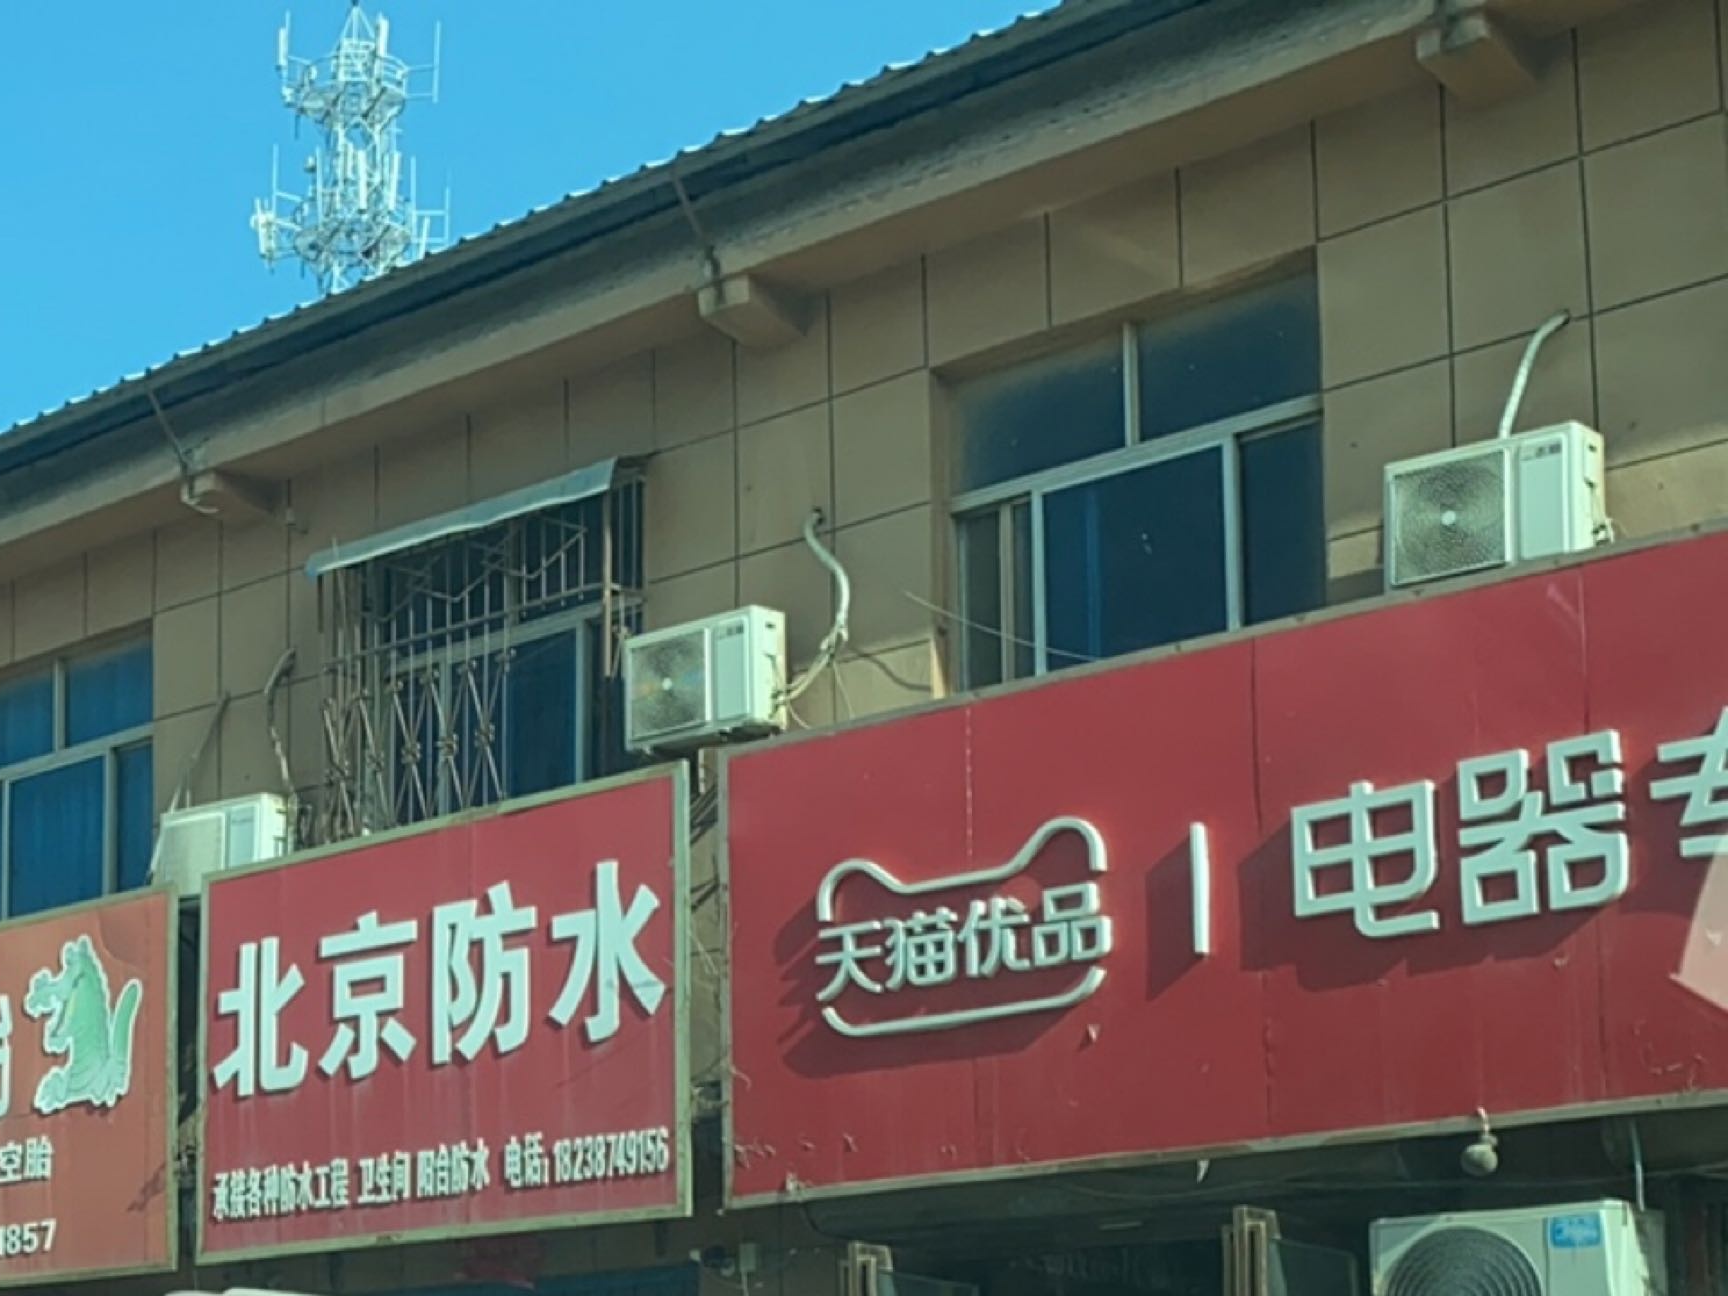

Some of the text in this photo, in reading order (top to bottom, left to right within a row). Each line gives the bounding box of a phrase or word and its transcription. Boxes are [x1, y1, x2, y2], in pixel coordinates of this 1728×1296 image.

[212, 860, 666, 1097] 北京防水
[816, 880, 1114, 1003] 天猫优品
[358, 1151, 411, 1204] 卫生间
